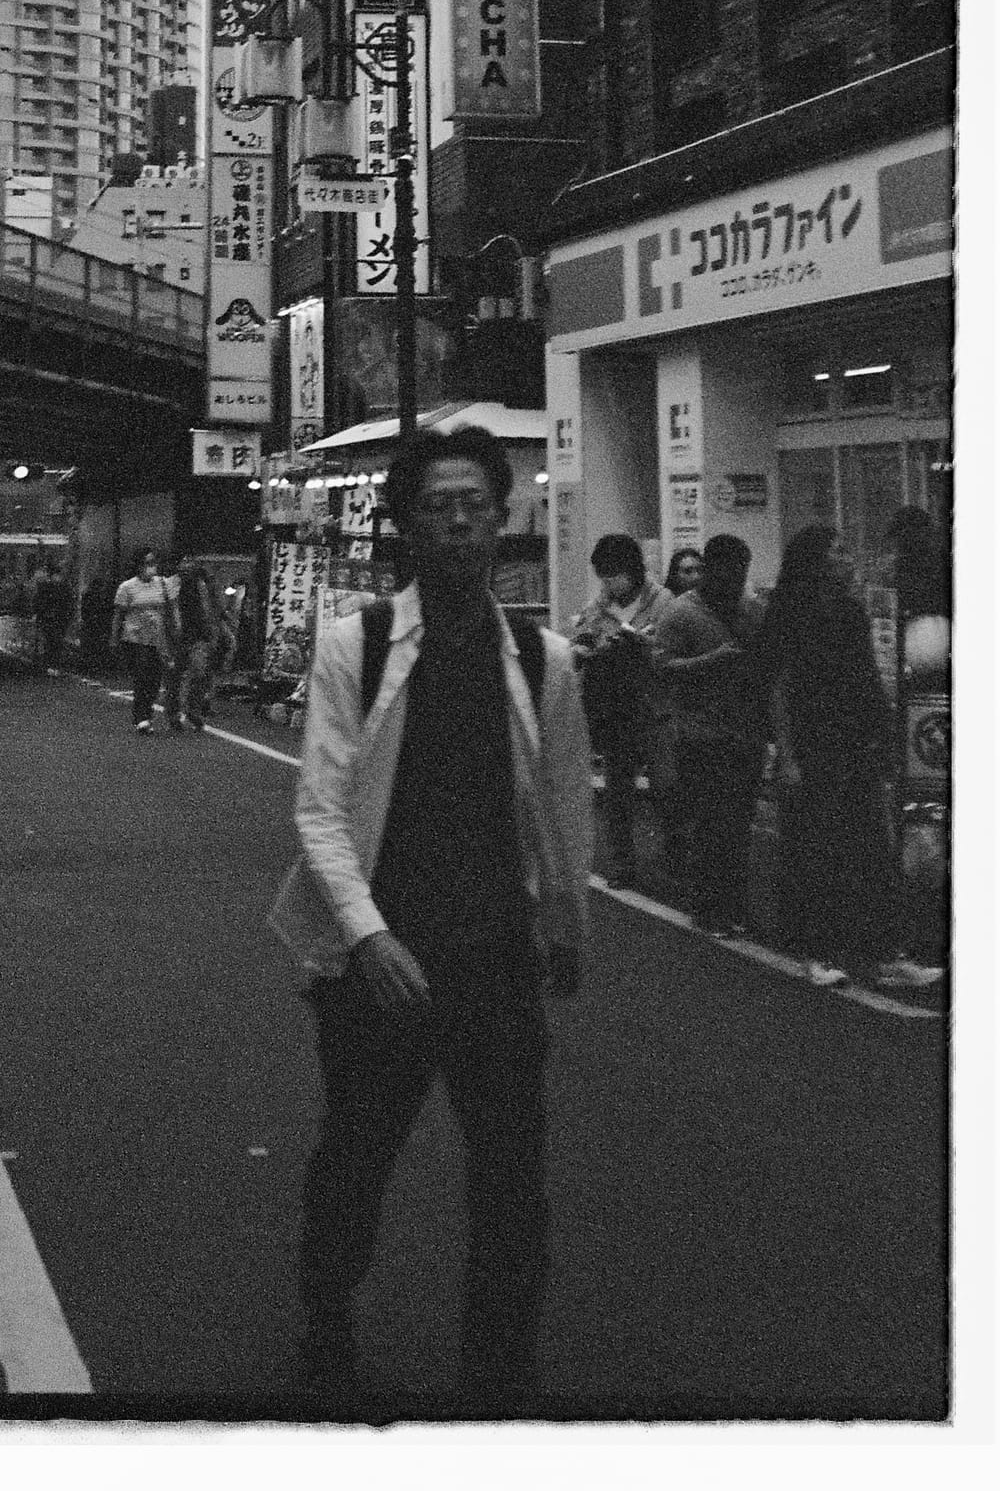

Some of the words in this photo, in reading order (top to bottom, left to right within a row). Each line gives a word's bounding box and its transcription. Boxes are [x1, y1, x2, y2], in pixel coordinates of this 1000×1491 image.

[304, 187, 379, 204] 代々木商店街
[366, 185, 392, 287] ーメン
[690, 183, 863, 277] ココカラファイン
